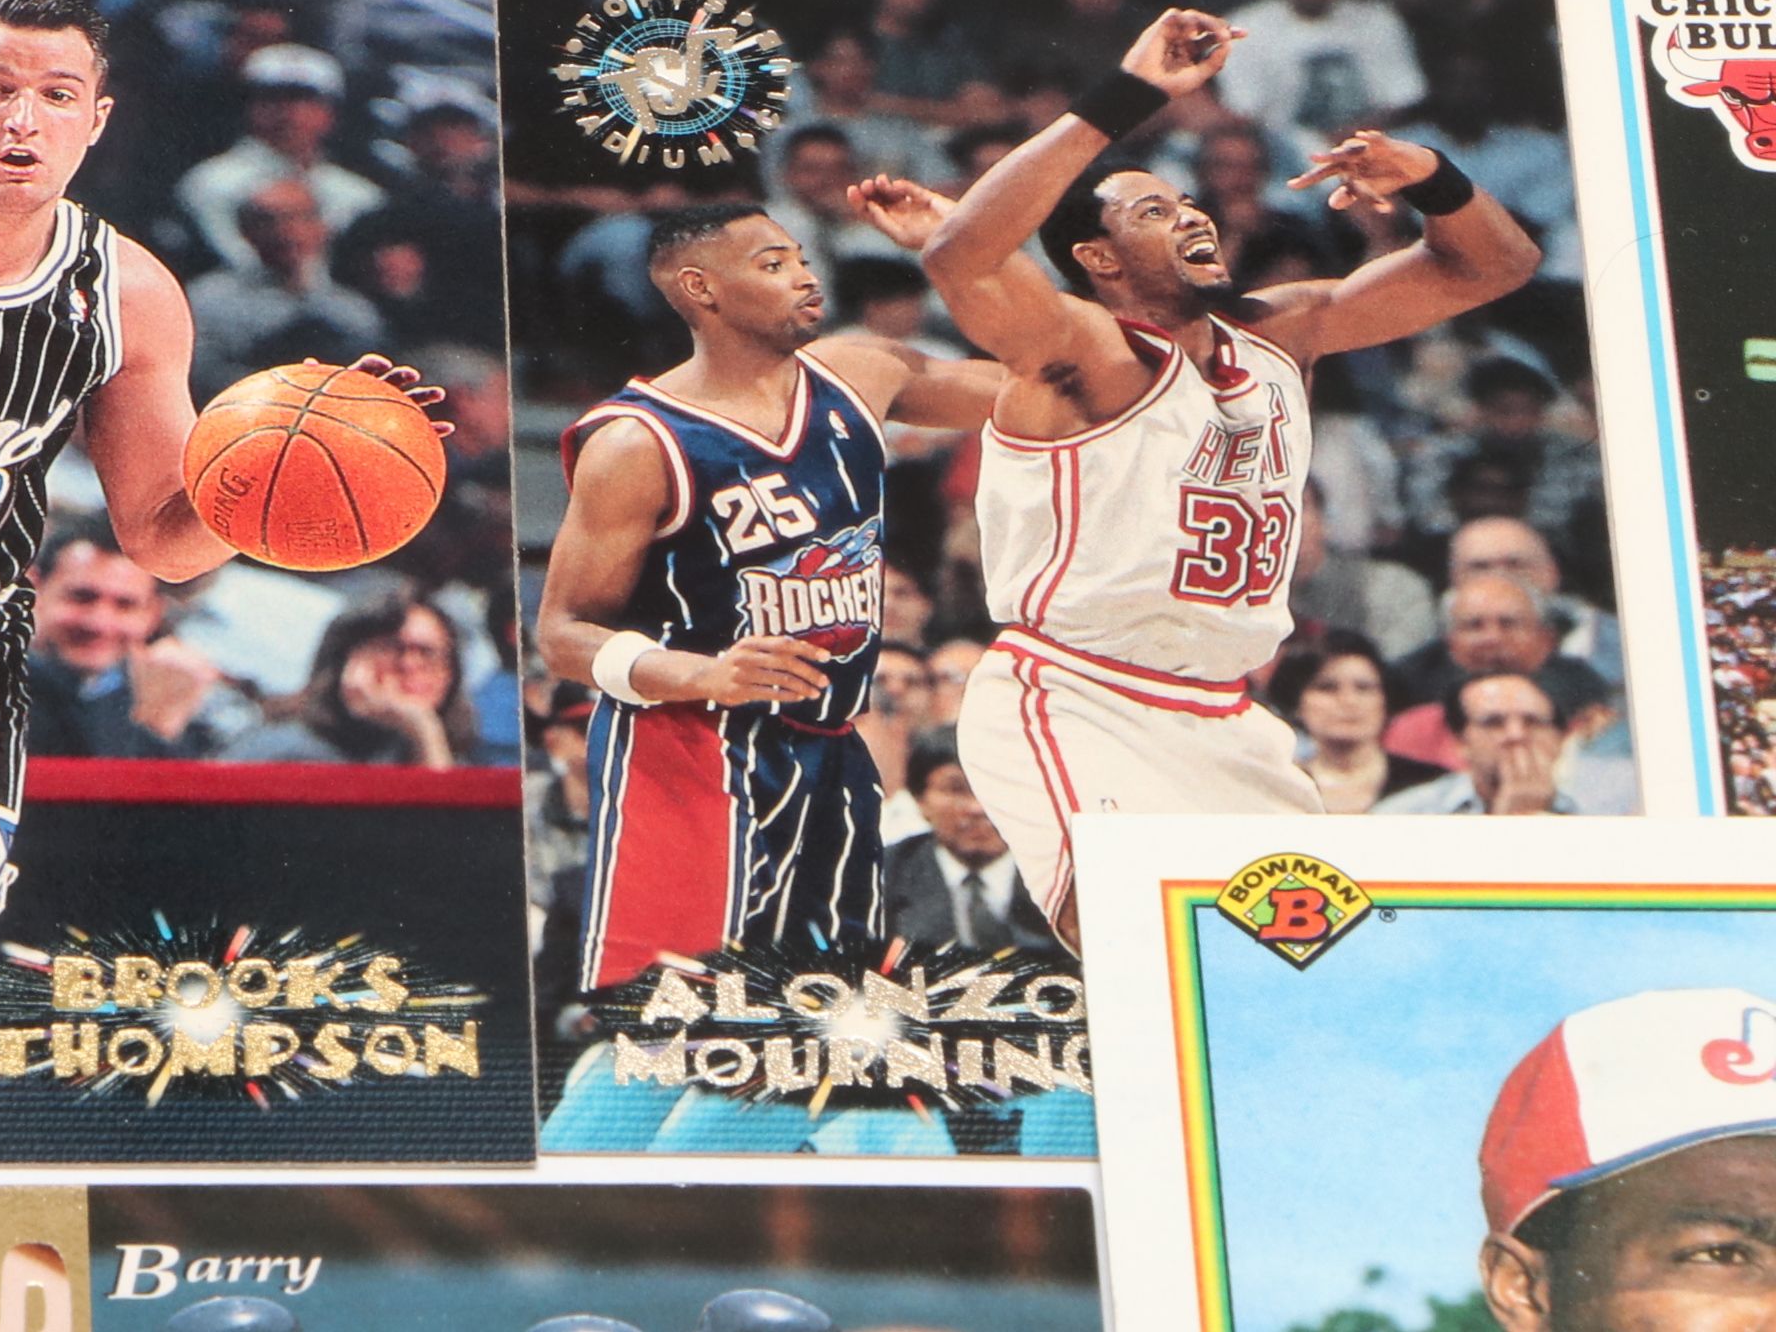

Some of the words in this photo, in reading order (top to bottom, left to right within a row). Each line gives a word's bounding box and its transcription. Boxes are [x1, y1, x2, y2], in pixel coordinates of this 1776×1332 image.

[1685, 22, 1776, 50] BUL
[556, 62, 733, 169] STADIUM
[711, 472, 817, 555] 25
[1168, 484, 1296, 608] 33
[1227, 858, 1360, 905] BOWMAN
[1259, 886, 1328, 943] B
[49, 955, 411, 1014] BROOKS
[640, 966, 1085, 1026] ALONZO
[107, 1243, 322, 1301] Barry
